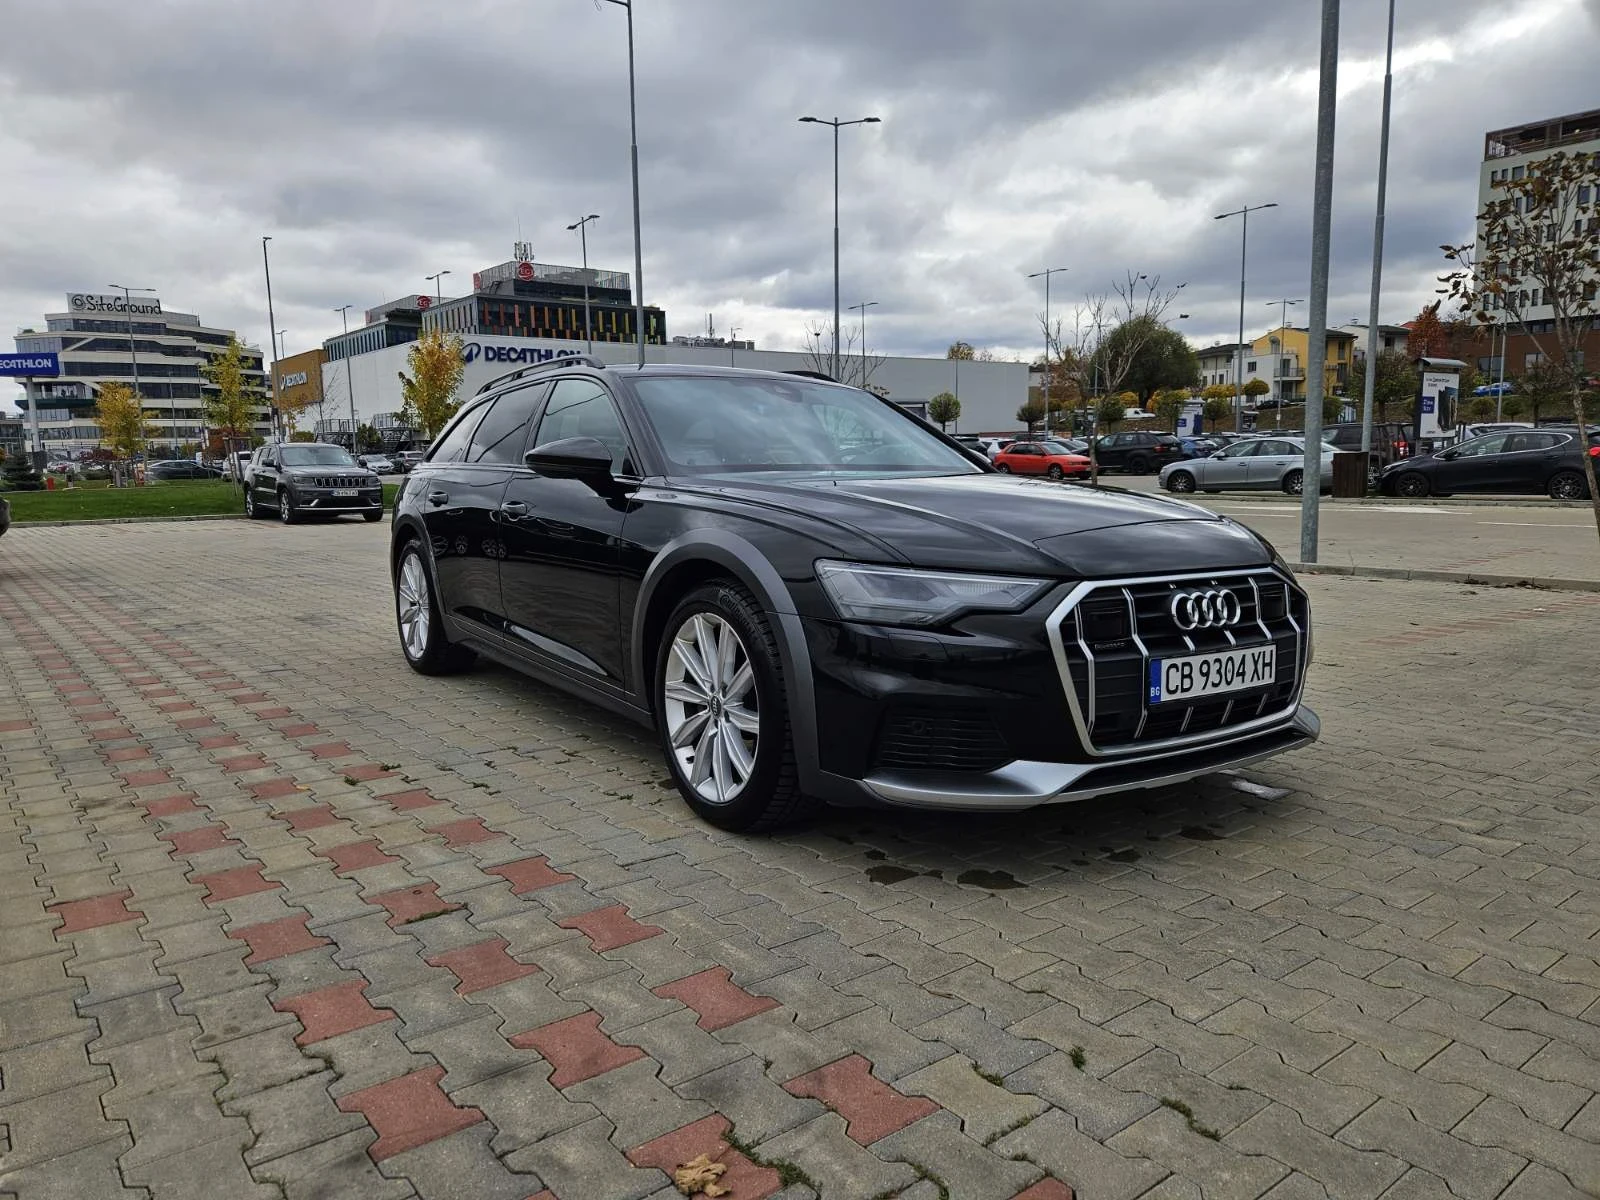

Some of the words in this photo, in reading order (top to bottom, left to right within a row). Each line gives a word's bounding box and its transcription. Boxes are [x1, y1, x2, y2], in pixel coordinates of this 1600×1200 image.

[85, 295, 162, 315] SiteGround
[1165, 662, 1194, 695] CB
[1199, 654, 1246, 690] 9304
[1250, 650, 1274, 682] XH
[1150, 686, 1160, 697] BG
